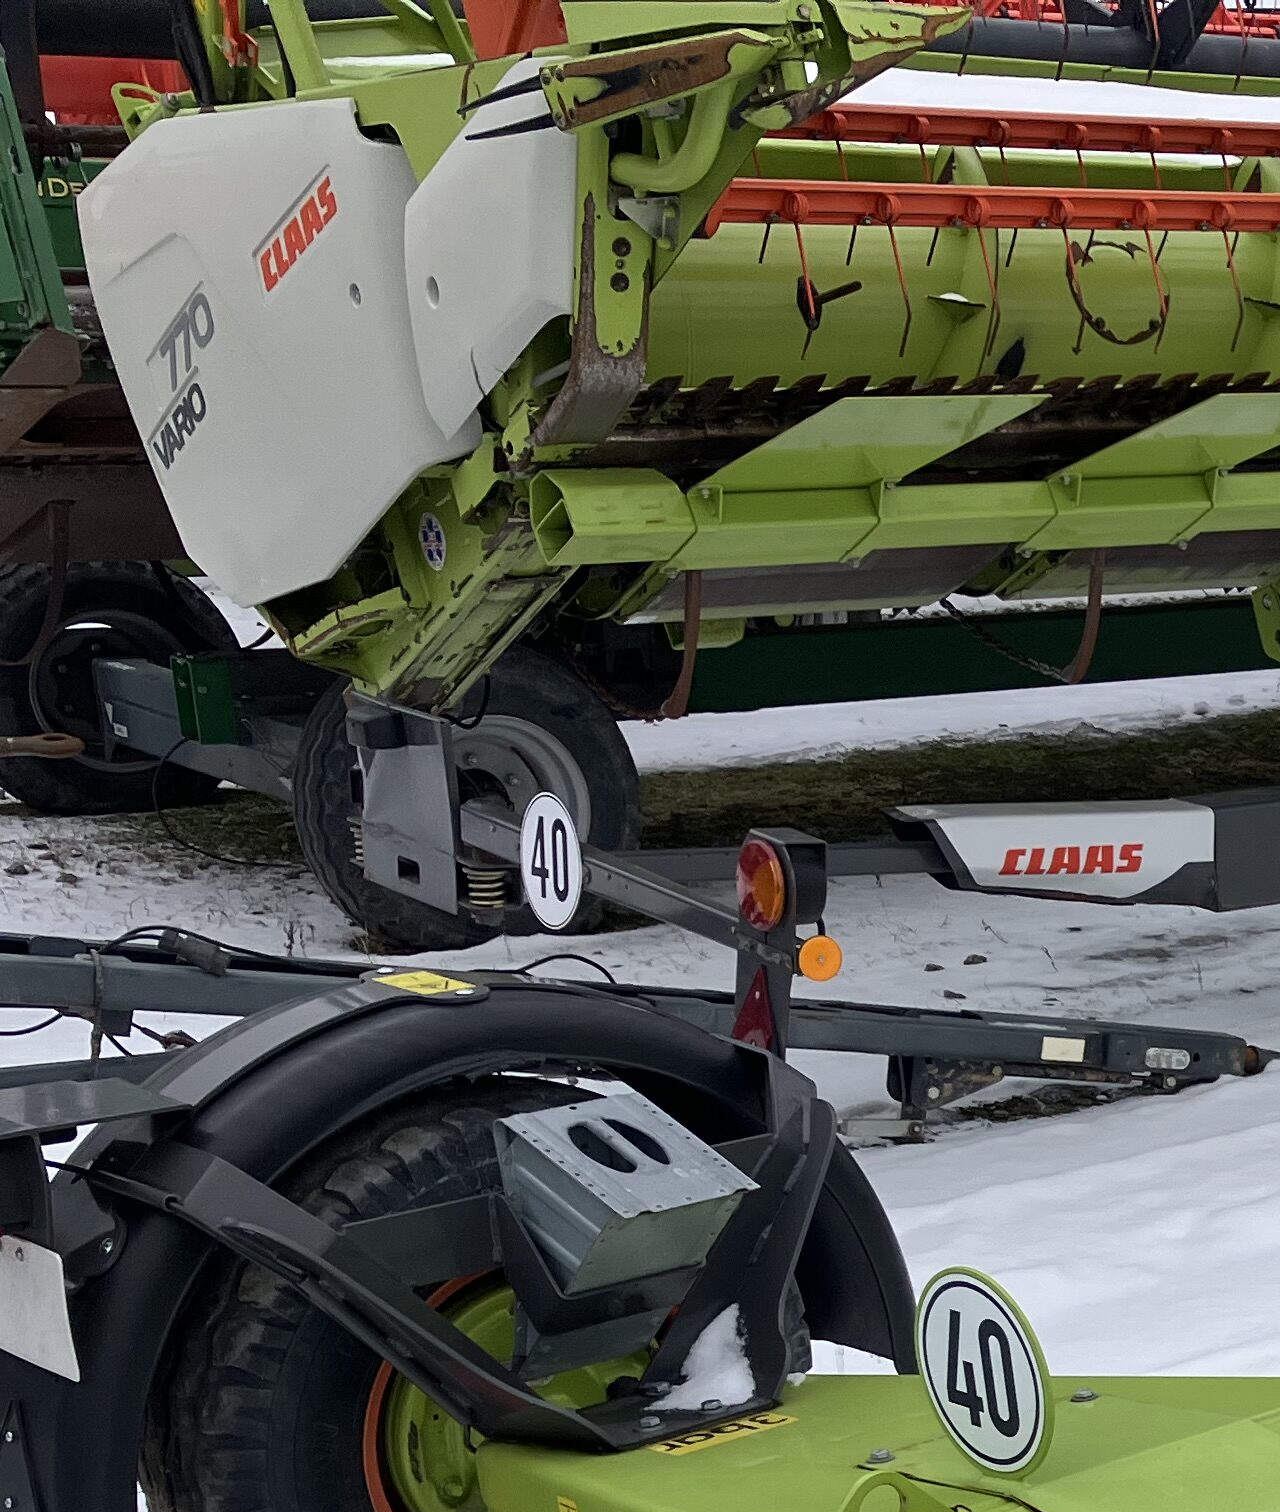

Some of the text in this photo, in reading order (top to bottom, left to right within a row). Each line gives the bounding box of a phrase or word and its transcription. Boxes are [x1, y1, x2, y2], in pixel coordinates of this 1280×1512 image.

[260, 175, 337, 292] CLAAS
[159, 292, 214, 393] 770
[152, 382, 207, 471] VARIO
[531, 815, 569, 903] 40
[998, 843, 1145, 876] CLAAS
[947, 1308, 1020, 1438] 40
